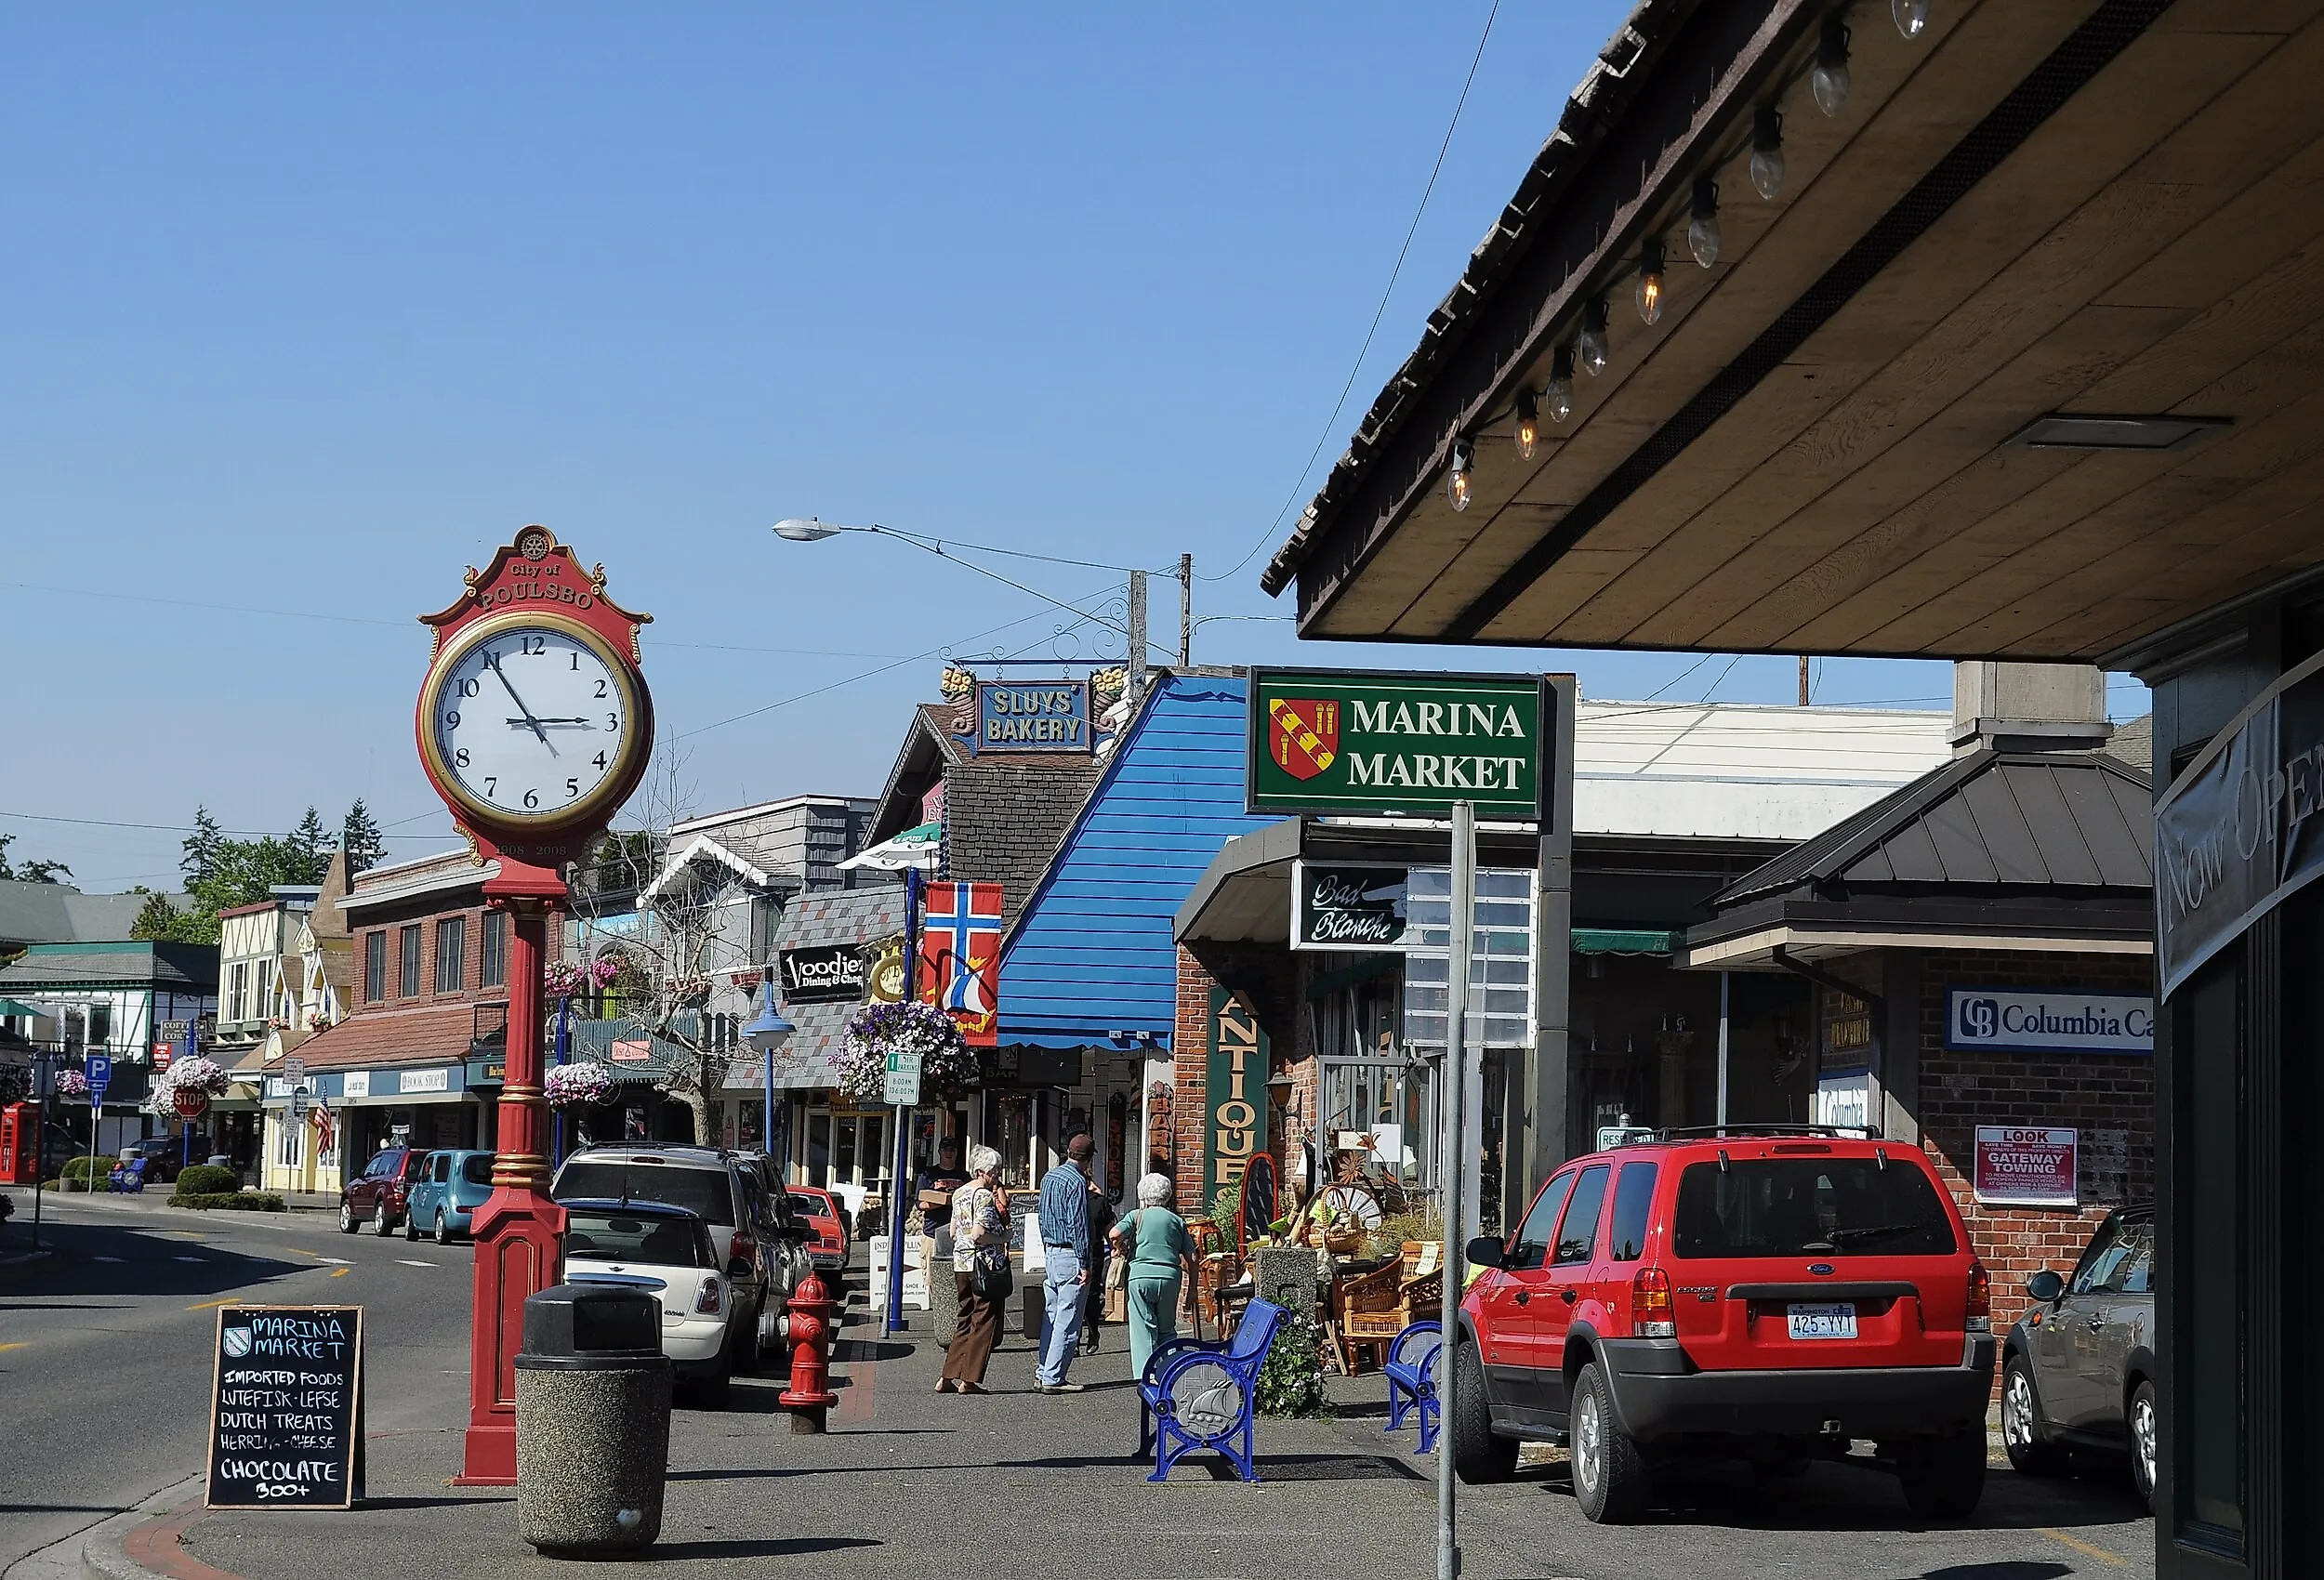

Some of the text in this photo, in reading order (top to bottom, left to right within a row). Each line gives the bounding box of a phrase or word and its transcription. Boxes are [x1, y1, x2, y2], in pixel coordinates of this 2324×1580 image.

[511, 563, 561, 578] City of
[480, 582, 593, 610] POULSBO
[521, 636, 547, 656] 12
[481, 651, 502, 671] 11
[569, 652, 580, 671] 1
[456, 678, 480, 698] 10
[593, 679, 608, 698] 2
[446, 711, 461, 731] 9
[604, 713, 618, 732] 3
[1350, 700, 1525, 738] MARINA
[987, 718, 1079, 742] BAKERY
[456, 748, 470, 768] 8
[592, 750, 607, 770] 4
[1346, 752, 1525, 790] MARKET
[483, 777, 497, 797] 7
[565, 778, 579, 797] 5
[523, 788, 538, 809] 6
[496, 846, 524, 856] 1908
[536, 846, 567, 856] 2008
[1312, 875, 1368, 907] Bad
[1311, 911, 1391, 941] Blanche
[802, 977, 831, 987] Dining
[832, 975, 839, 985] &
[2002, 1005, 2121, 1036] Columbia
[92, 1060, 106, 1077] P
[407, 1074, 440, 1087] BOOK STOP
[175, 1093, 205, 1106] STOP
[1215, 990, 1259, 1205] ANTIQUE
[2003, 1130, 2049, 1142] LOOK
[1987, 1152, 2064, 1164] GATEWAY
[1993, 1163, 2056, 1173] TOWING
[253, 1318, 345, 1339] MARINA
[255, 1338, 345, 1360] MARKET
[224, 1370, 343, 1386] IMPORTED FOODS
[221, 1412, 333, 1430] DUTCH TREATS
[220, 1458, 339, 1481] CHOCOLATE
[256, 1482, 310, 1498] 300+
